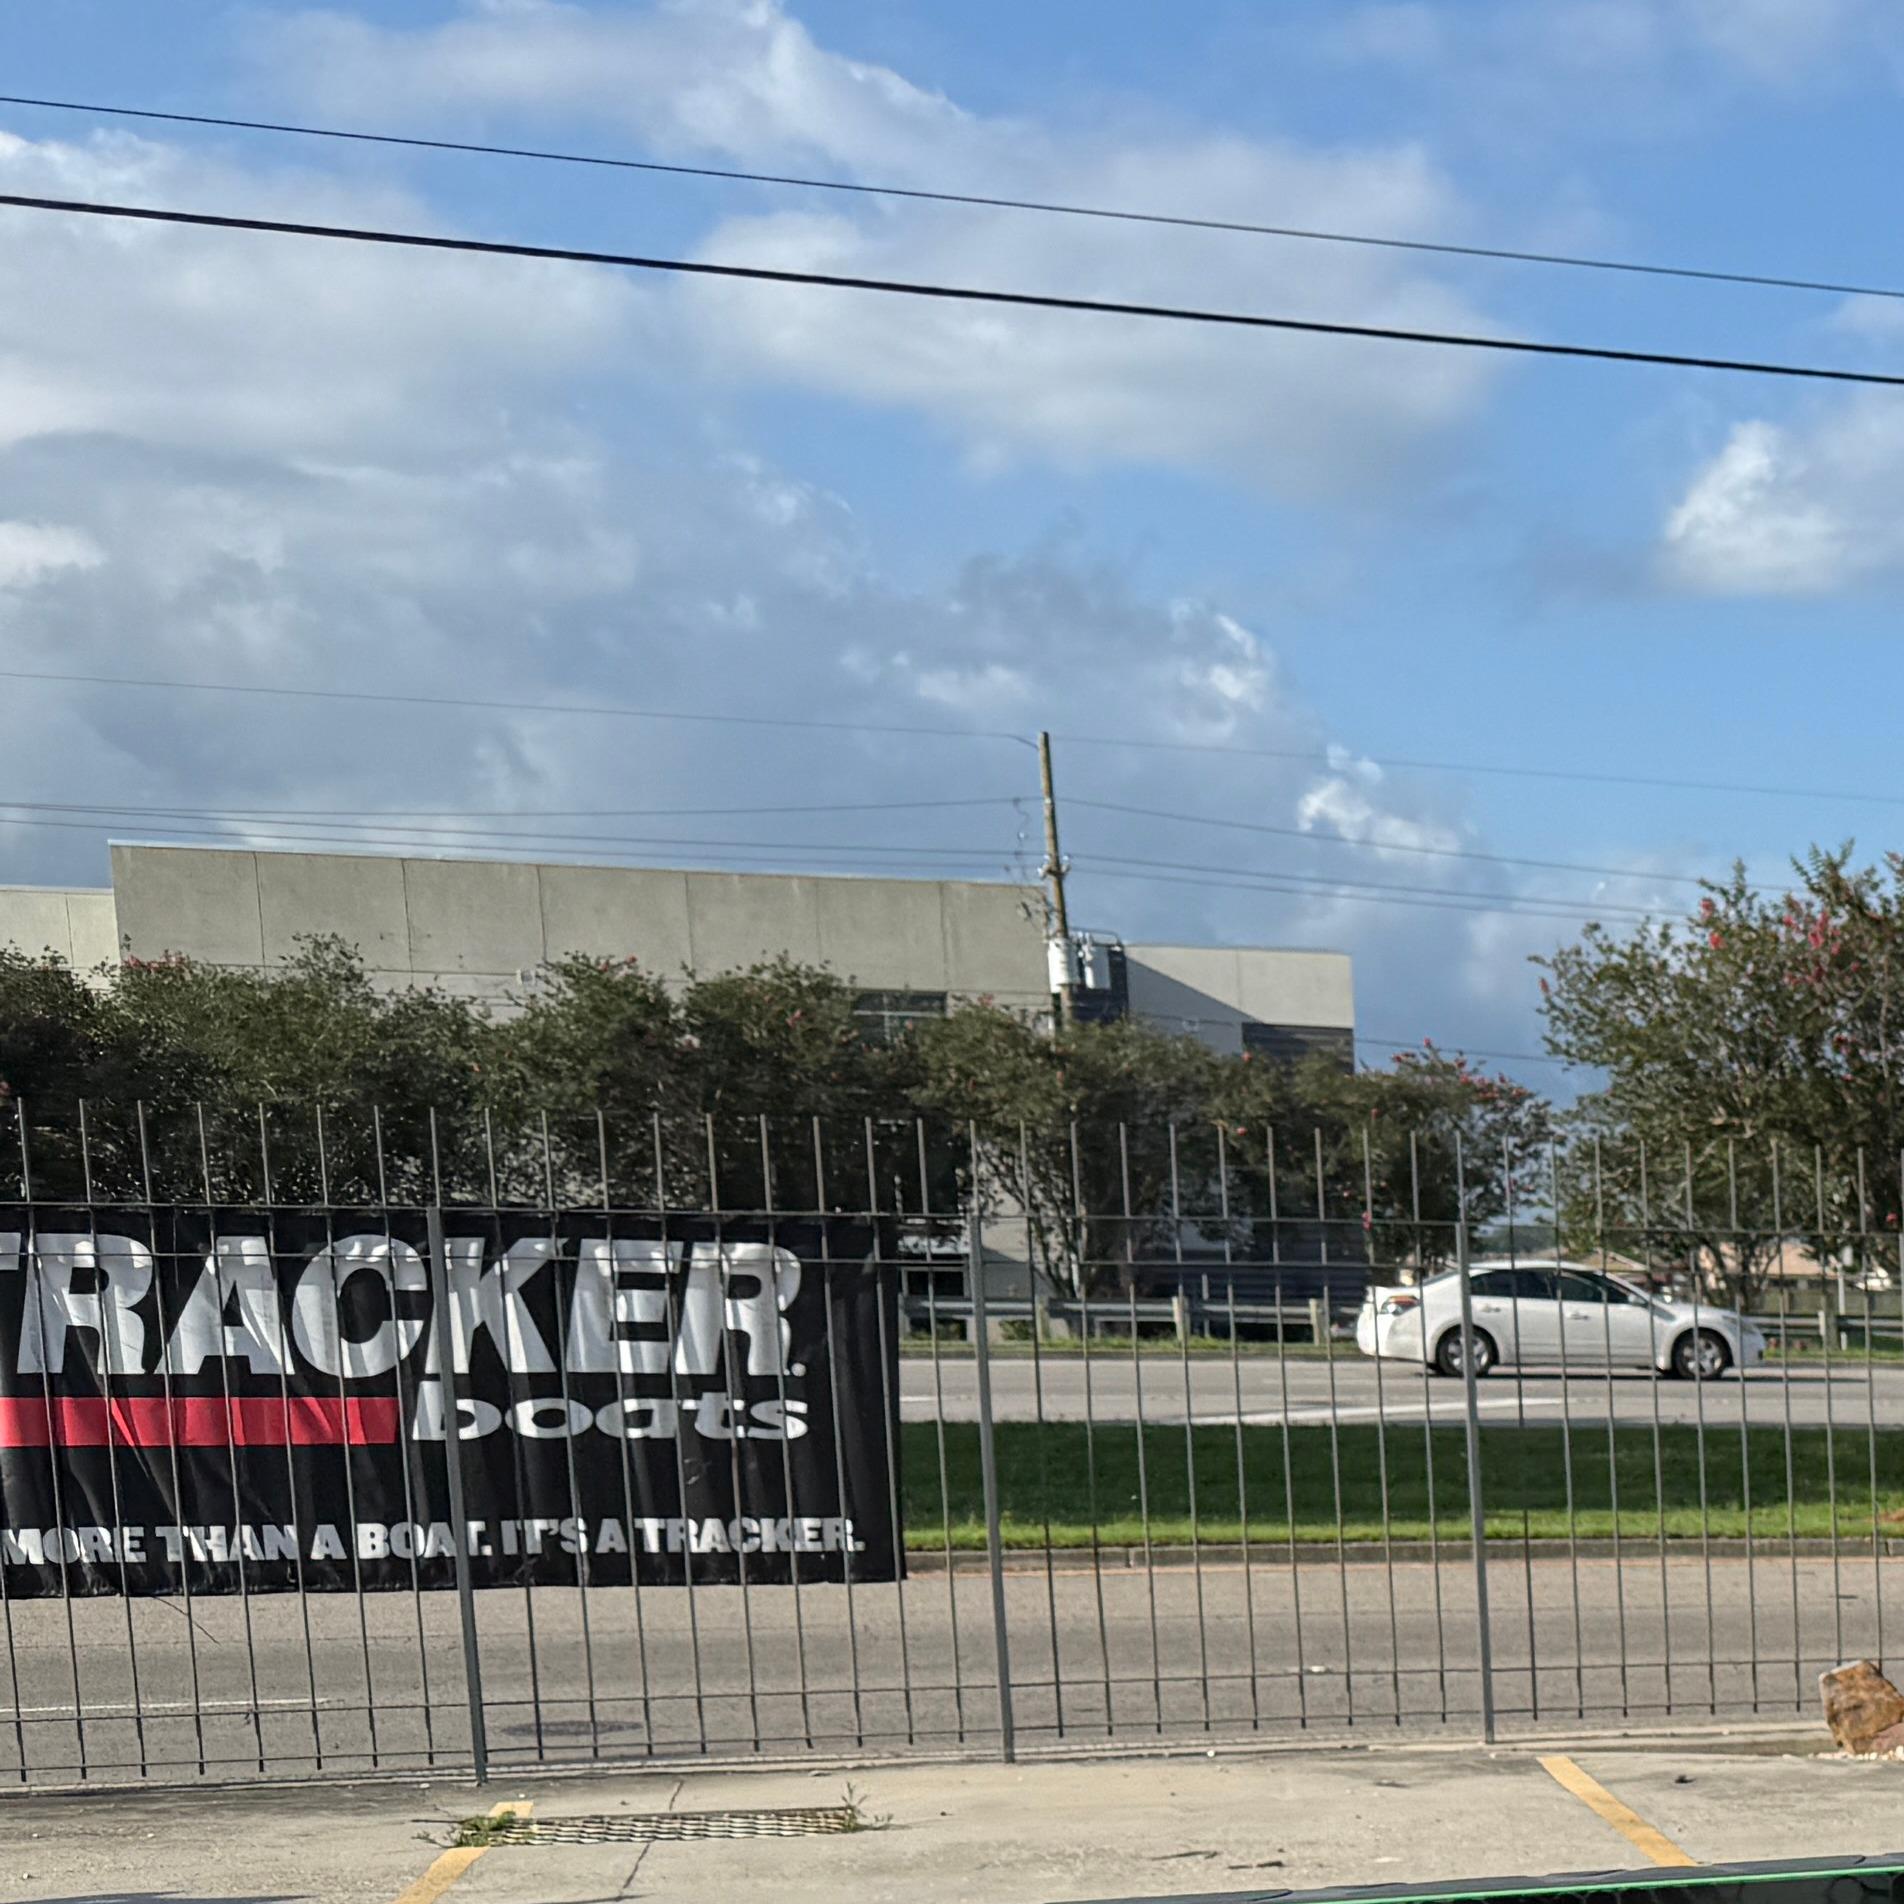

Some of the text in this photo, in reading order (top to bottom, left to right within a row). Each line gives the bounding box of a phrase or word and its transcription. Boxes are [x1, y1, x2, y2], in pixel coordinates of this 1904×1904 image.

[412, 1381, 808, 1440] boats
[1, 1518, 866, 1566] MORE THAN A BOAT. IT'S A TRACKER.
